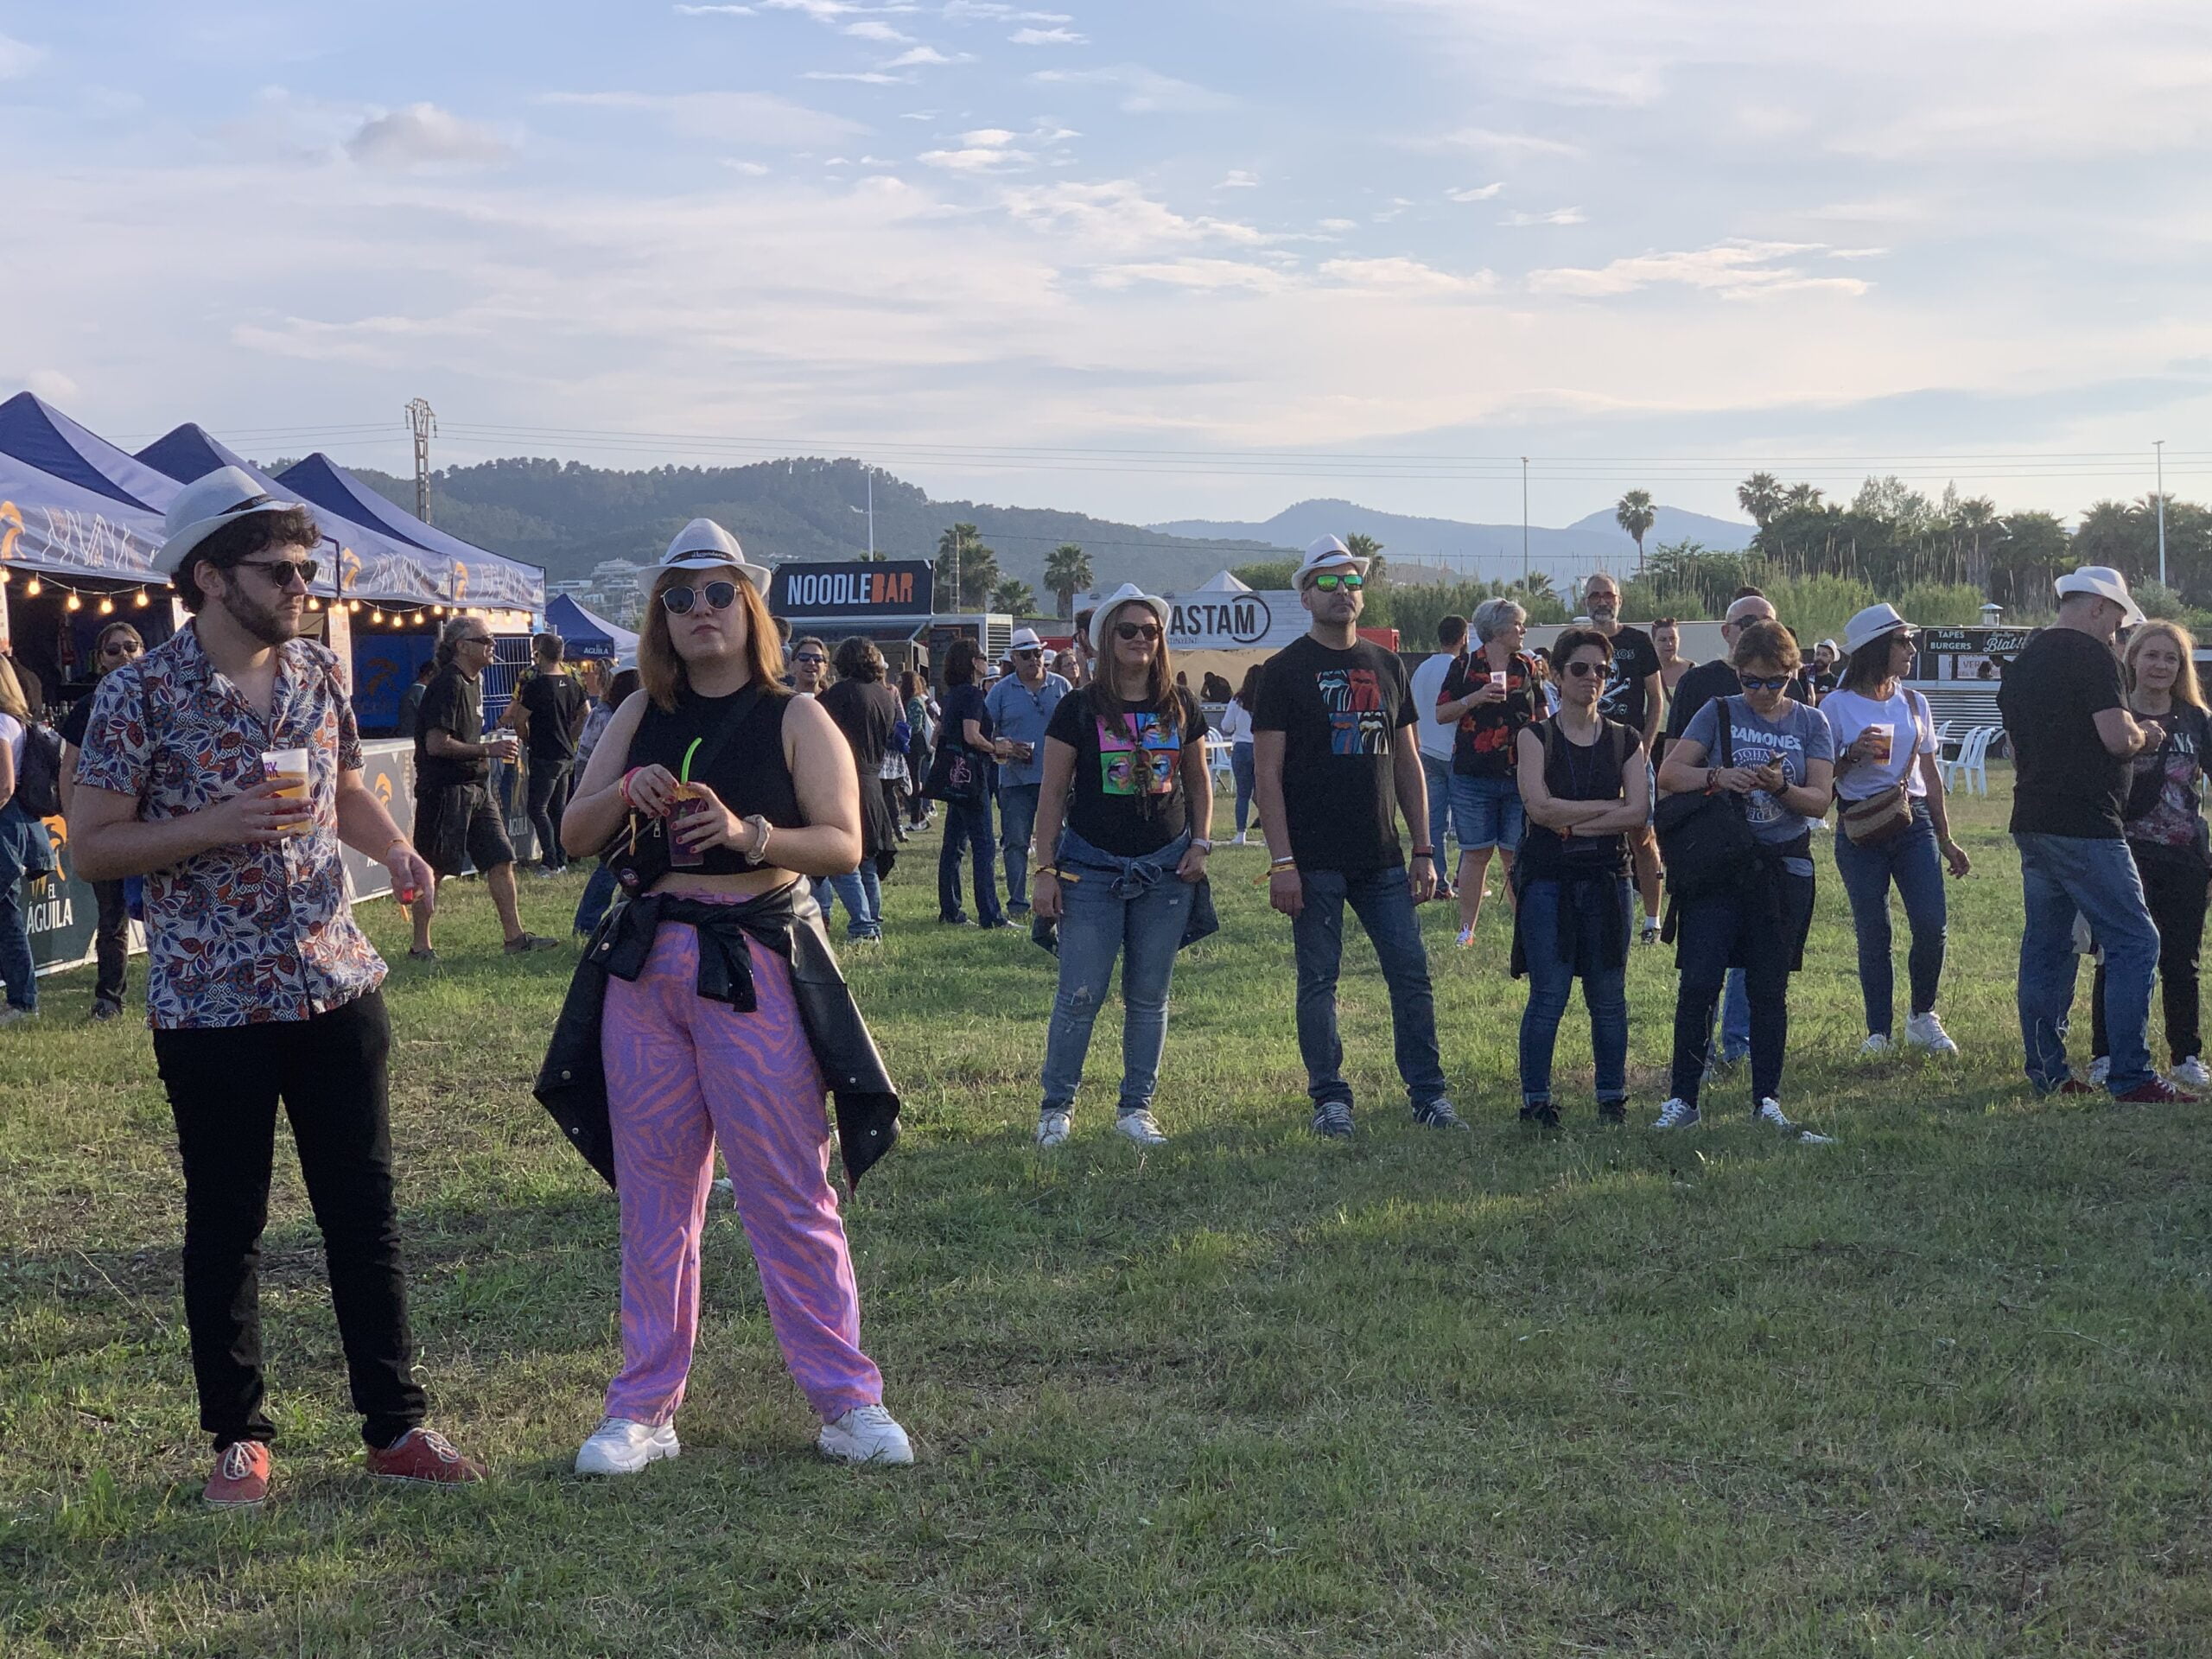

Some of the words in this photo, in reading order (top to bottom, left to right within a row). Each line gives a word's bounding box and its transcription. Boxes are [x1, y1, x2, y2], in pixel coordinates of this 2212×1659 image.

[788, 573, 913, 605] NOODLEBAR
[1170, 604, 1255, 635] ASTAM
[1731, 725, 1802, 750] RAMONES
[48, 883, 56, 899] EL
